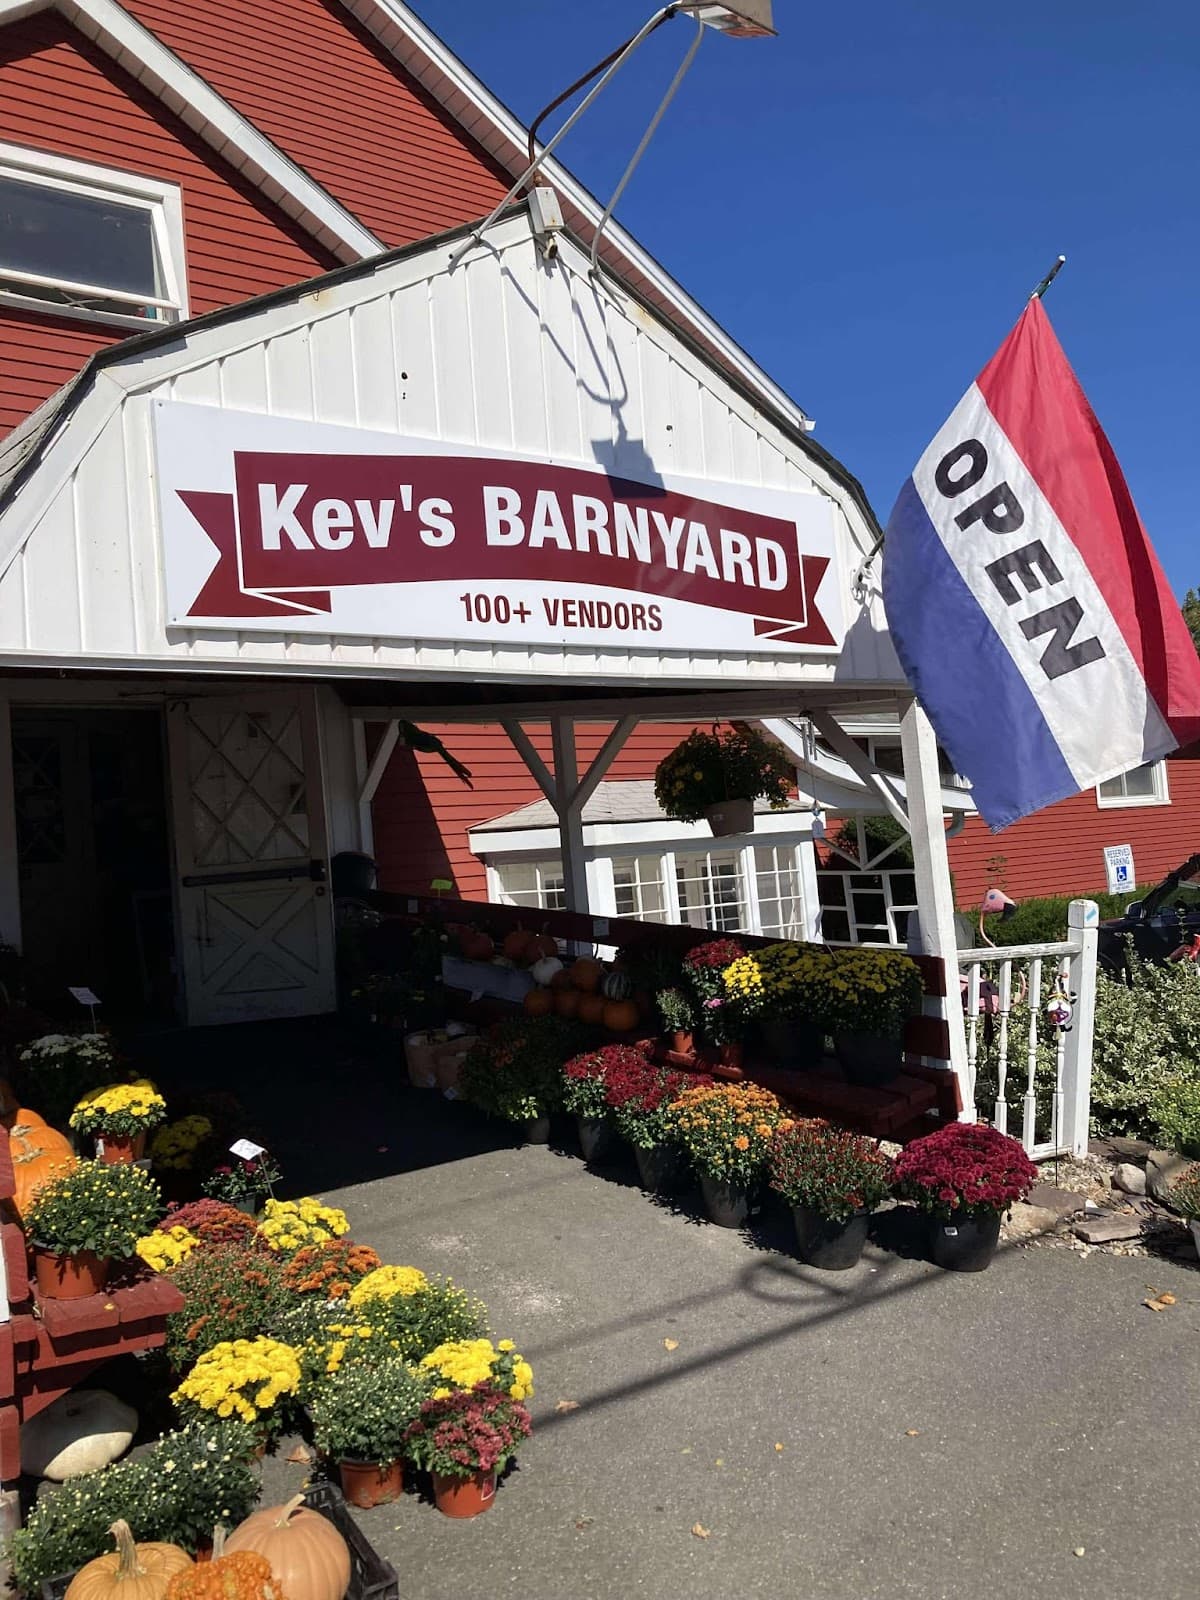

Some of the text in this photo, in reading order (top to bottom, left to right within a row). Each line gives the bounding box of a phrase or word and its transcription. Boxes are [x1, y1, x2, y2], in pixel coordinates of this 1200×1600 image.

[257, 483, 789, 591] Kev's BARNYARD
[935, 438, 1107, 681] OPEN
[460, 592, 663, 632] 100+ VENDORS
[1106, 847, 1131, 858] RESERVED
[1110, 856, 1130, 866] PARKING
